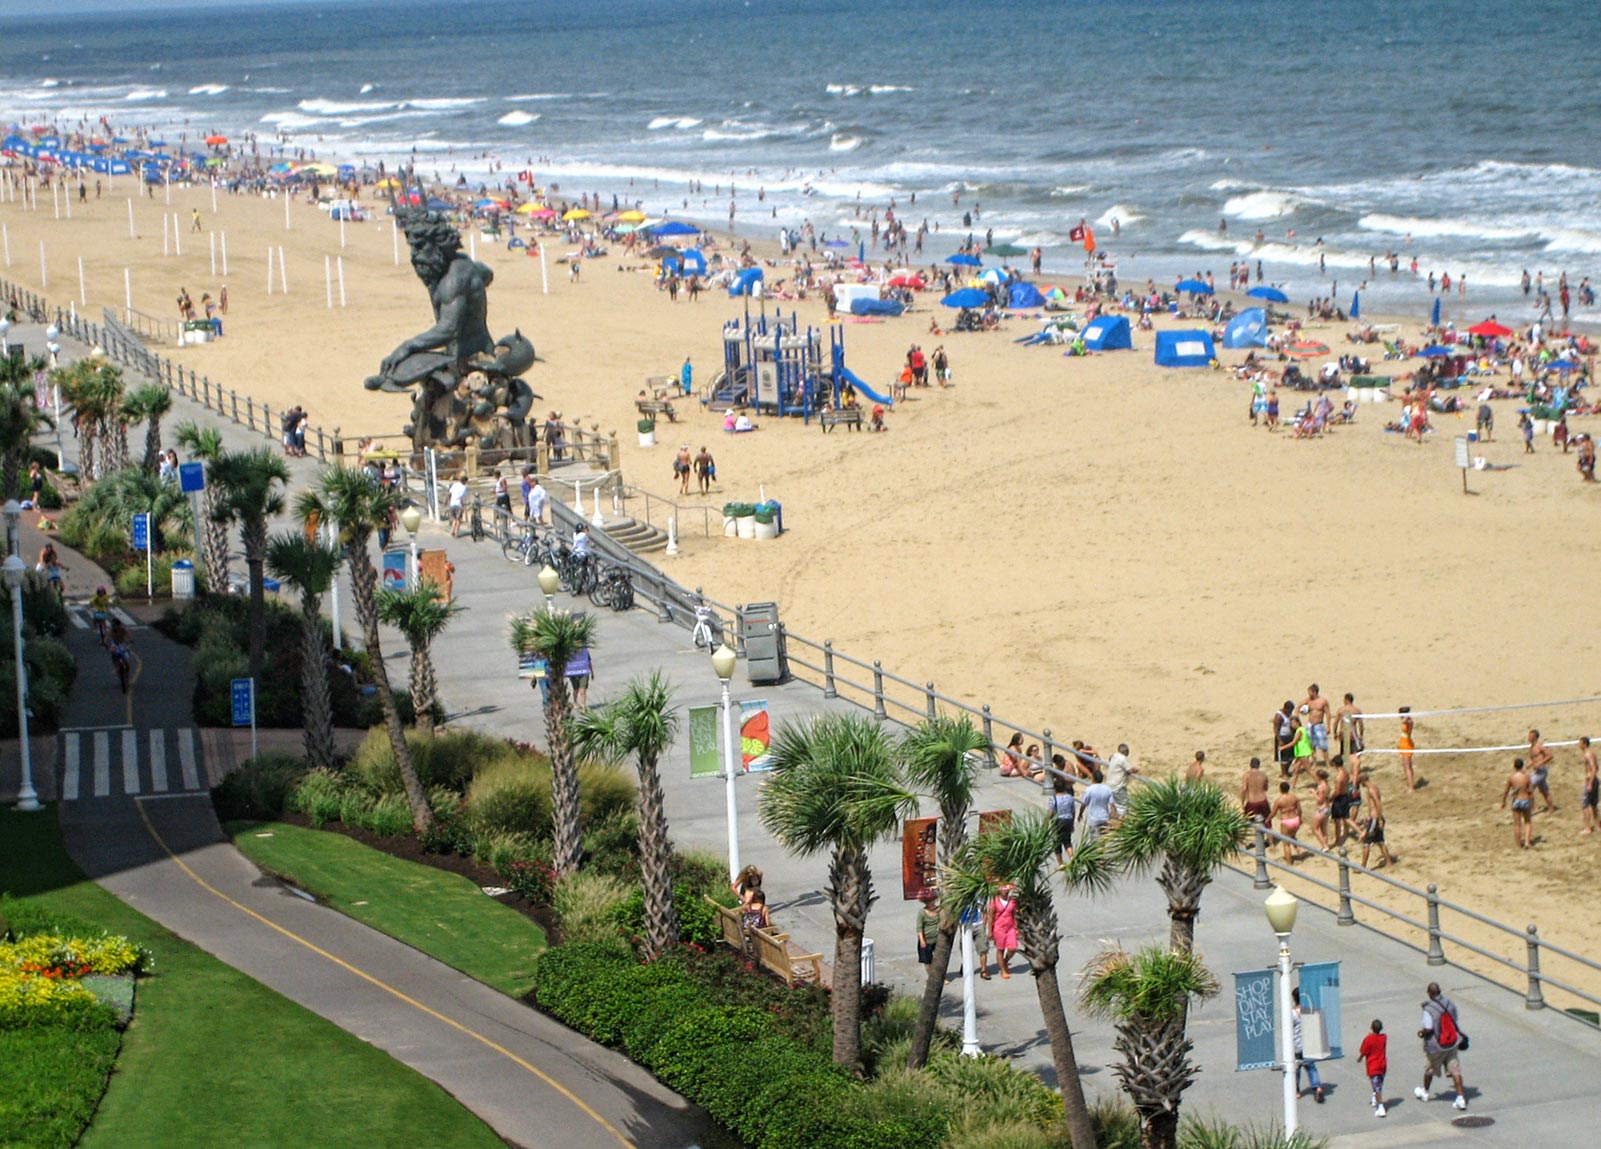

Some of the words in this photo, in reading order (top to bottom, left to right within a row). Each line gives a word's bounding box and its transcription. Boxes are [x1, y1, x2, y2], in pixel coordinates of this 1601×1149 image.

[1235, 977, 1271, 1000] SHOP
[1238, 991, 1272, 1015] DINE
[1242, 1006, 1269, 1028] STAY
